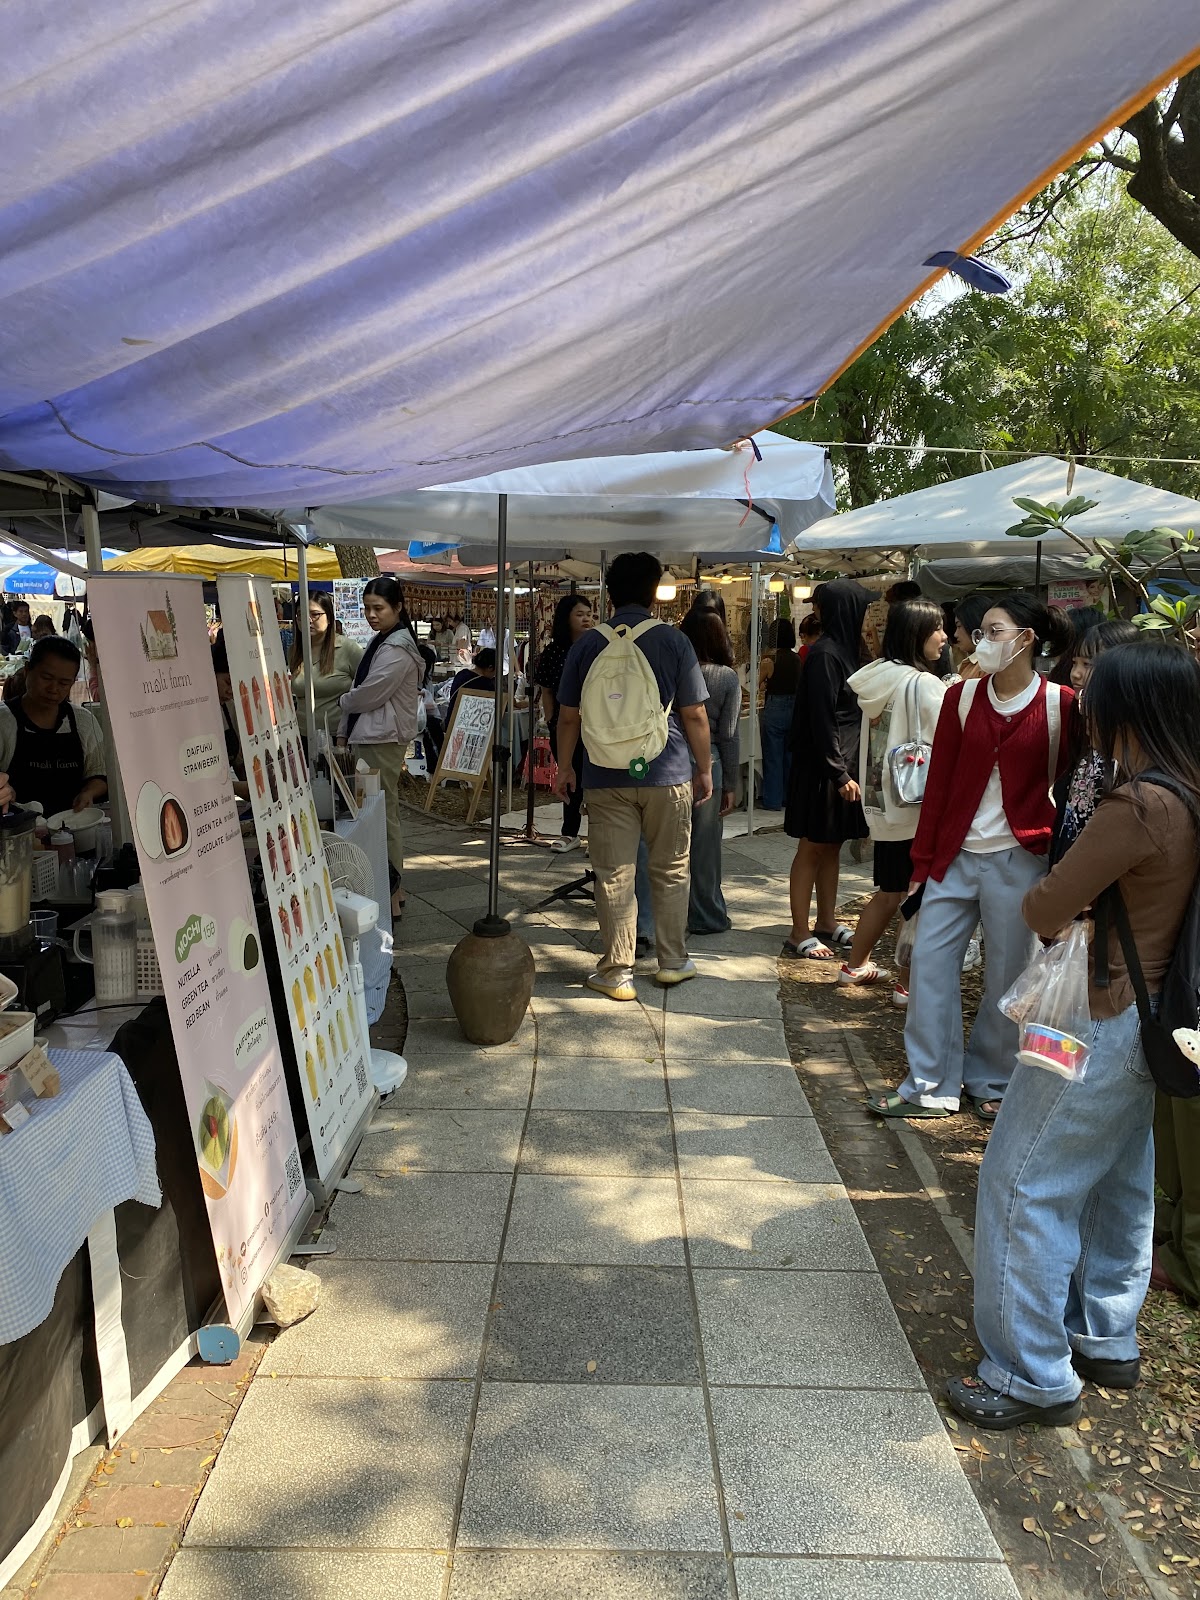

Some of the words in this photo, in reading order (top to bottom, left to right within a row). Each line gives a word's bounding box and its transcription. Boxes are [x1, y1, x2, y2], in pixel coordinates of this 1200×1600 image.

[142, 669, 168, 694] mali
[169, 667, 192, 689] farm
[186, 742, 213, 758] DAIFUKU
[56, 760, 79, 768] farm
[184, 755, 220, 776] STRAWBERRY
[194, 805, 203, 817] RED
[204, 799, 218, 812] BEAN
[196, 824, 212, 837] GREEN
[212, 818, 222, 828] TEA
[198, 836, 224, 857] CHOCOLATE
[177, 920, 200, 958] MOCHI
[177, 963, 201, 989] NUTELLA
[181, 986, 198, 1009] GREEN
[197, 979, 209, 995] TEA
[185, 1013, 196, 1029] RED
[196, 1000, 211, 1020] BEAN
[236, 1026, 254, 1056] DAIFUKU
[254, 1017, 267, 1031] CAKE
